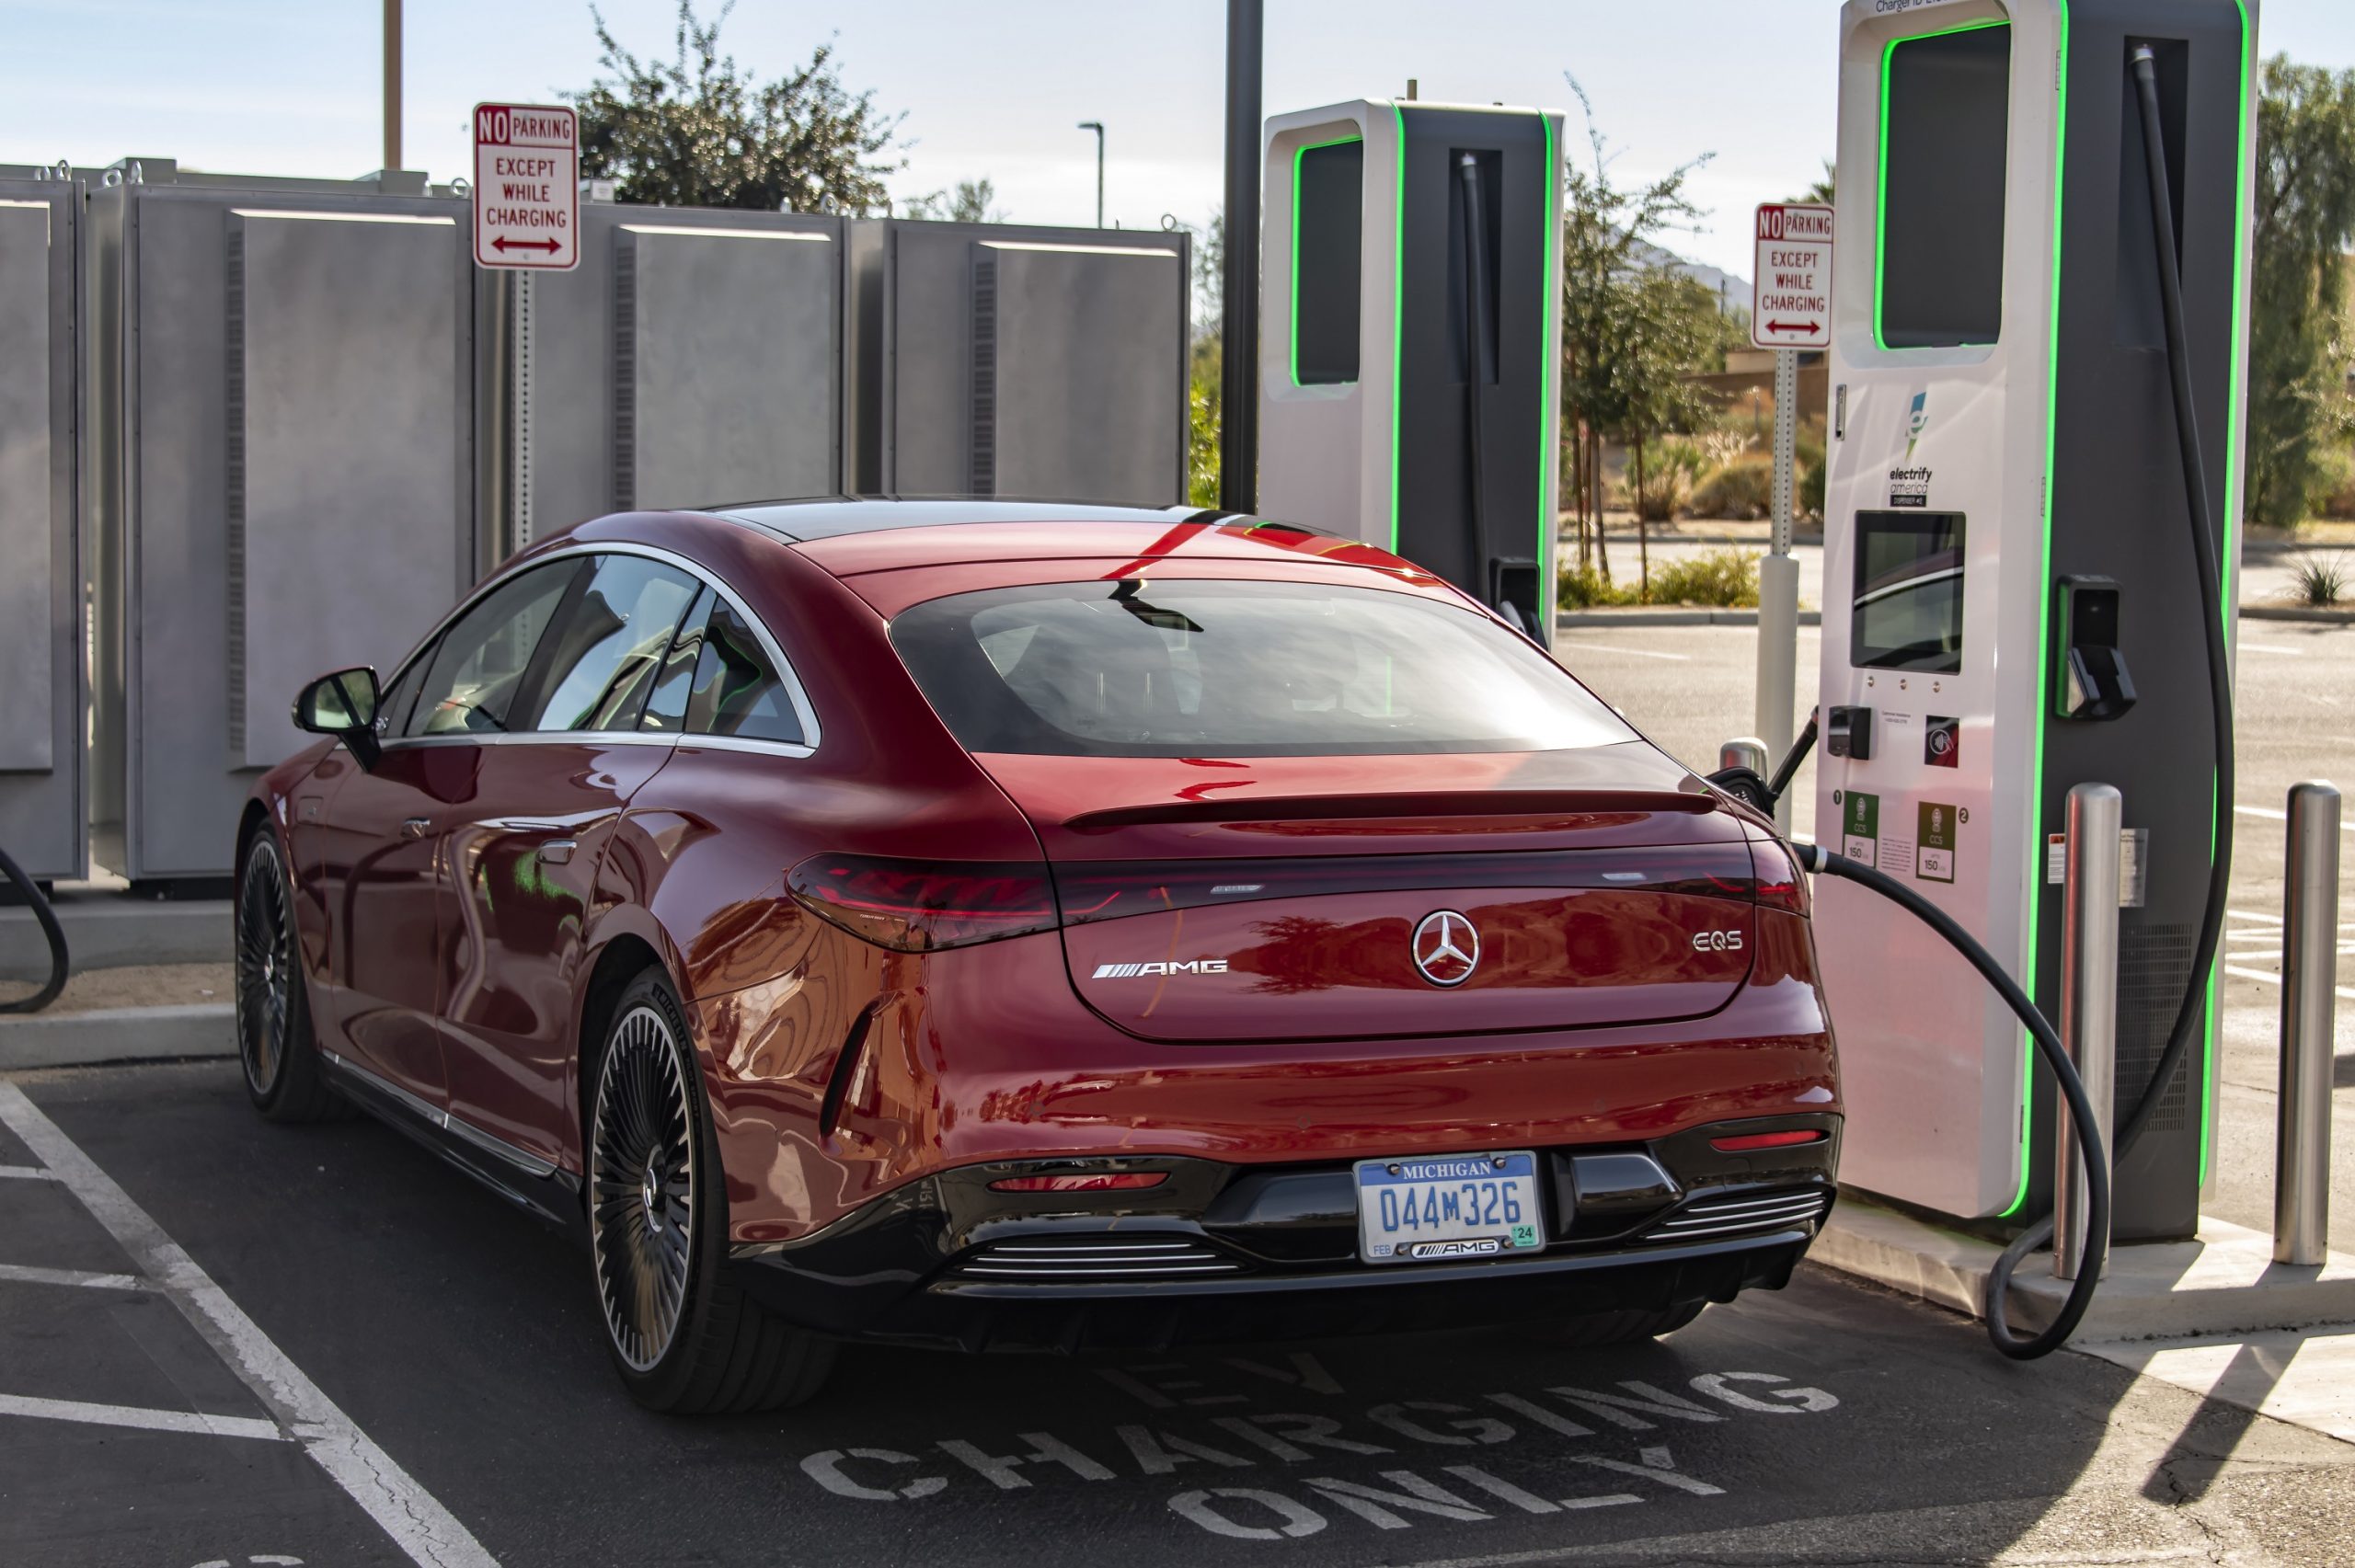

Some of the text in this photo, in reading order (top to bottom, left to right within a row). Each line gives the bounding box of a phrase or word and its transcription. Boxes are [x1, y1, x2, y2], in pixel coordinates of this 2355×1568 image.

[479, 110, 570, 143] NO PARKING
[496, 158, 556, 177] EXCEPT
[502, 184, 550, 202] WHILE
[487, 208, 567, 228] CHARGING
[1759, 211, 1831, 239] NO PARKING
[1771, 251, 1818, 268] EXCEPT
[1775, 273, 1813, 290] WHILE
[1762, 295, 1825, 313] CHARGING
[1890, 467, 1932, 483] electrify
[1890, 484, 1928, 494] america
[1854, 823, 1867, 833] CCS
[1929, 834, 1943, 845] CCS
[1849, 846, 1862, 858] 150
[1924, 859, 1938, 871] 150
[1693, 930, 1743, 952] EQS
[1136, 960, 1228, 978] AMG
[1403, 1162, 1491, 1179] MICHIGAN
[1380, 1182, 1521, 1232] 044M326
[1518, 1227, 1533, 1239] 24
[1373, 1245, 1391, 1255] FEB
[1442, 1242, 1495, 1254] AMG
[1091, 1353, 1345, 1408] EV
[798, 1371, 1840, 1502] CHARGING
[1166, 1447, 1727, 1540] ONLY
